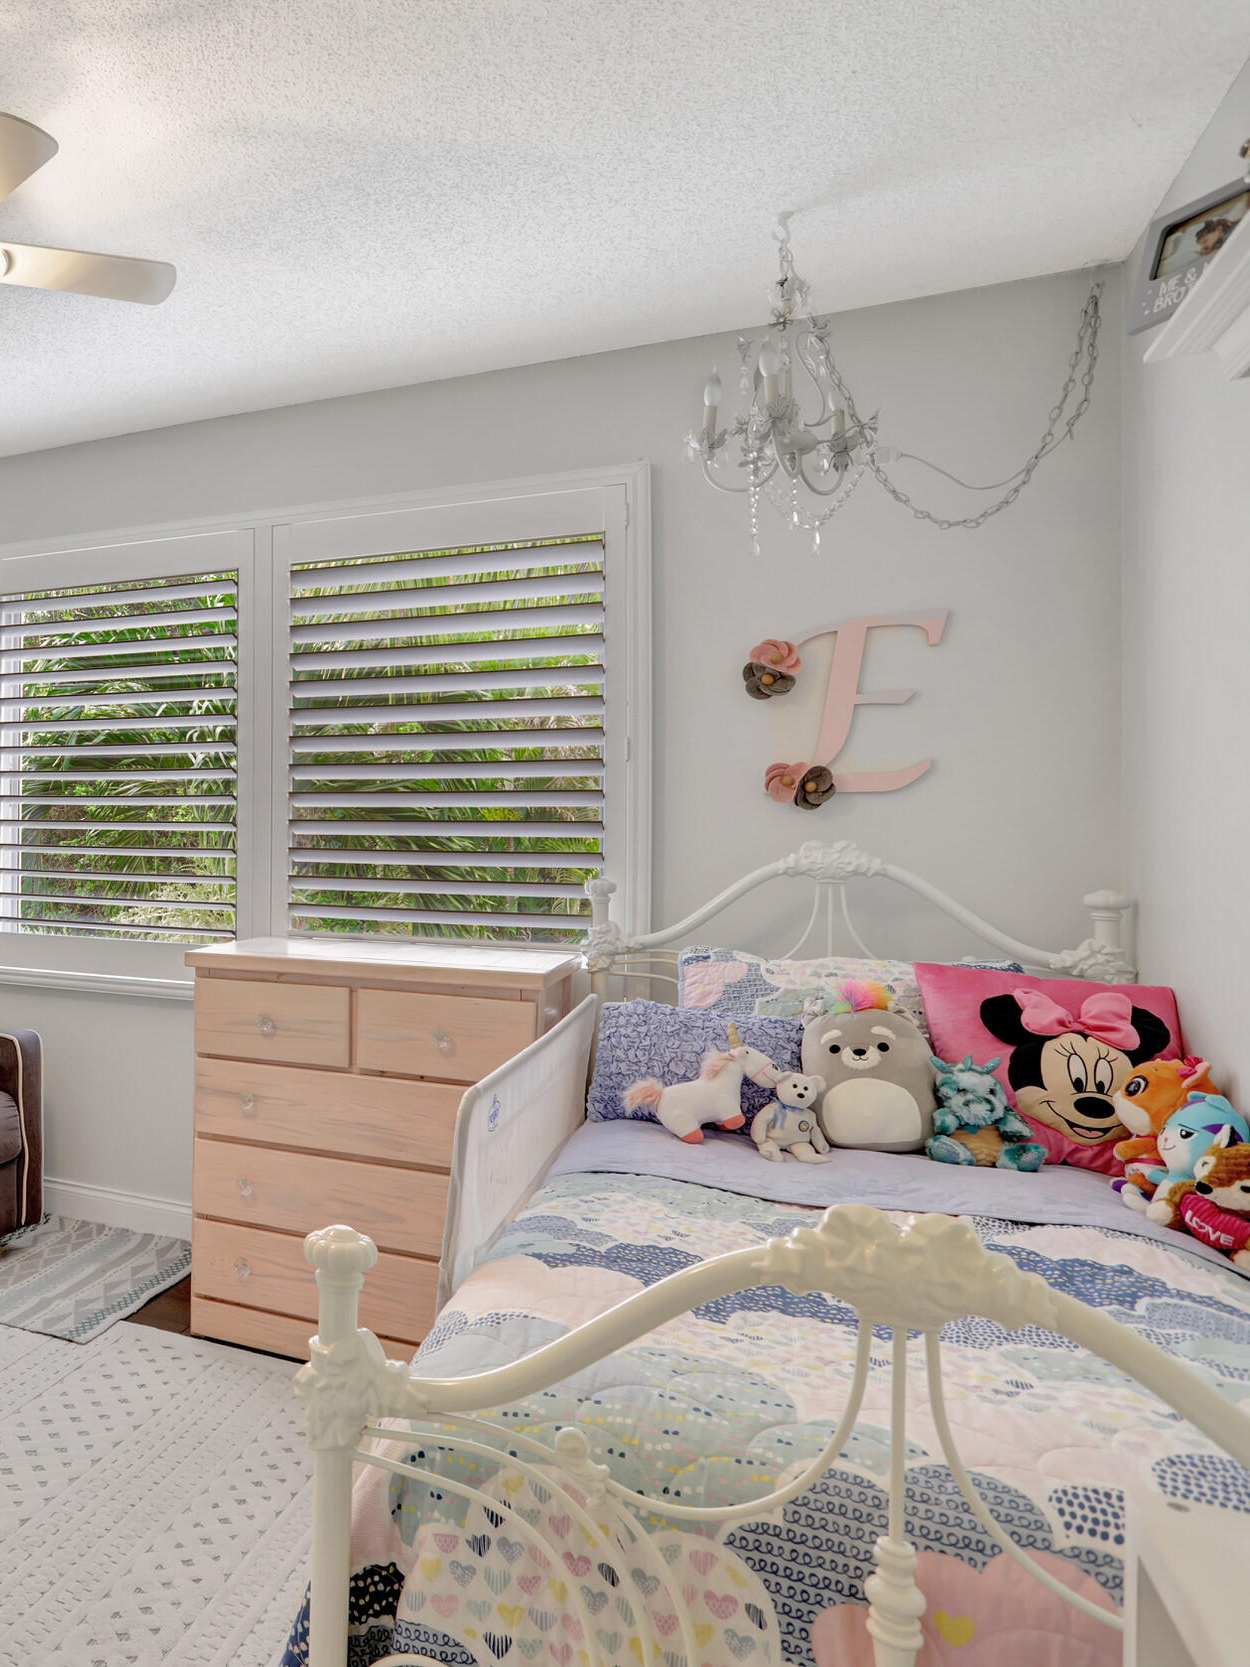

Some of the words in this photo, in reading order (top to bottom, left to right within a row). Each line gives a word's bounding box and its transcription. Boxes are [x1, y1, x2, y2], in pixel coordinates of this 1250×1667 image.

[1159, 274, 1182, 297] ME
[1184, 267, 1197, 284] &
[762, 607, 950, 794] E
[1184, 1209, 1235, 1246] LOVE
